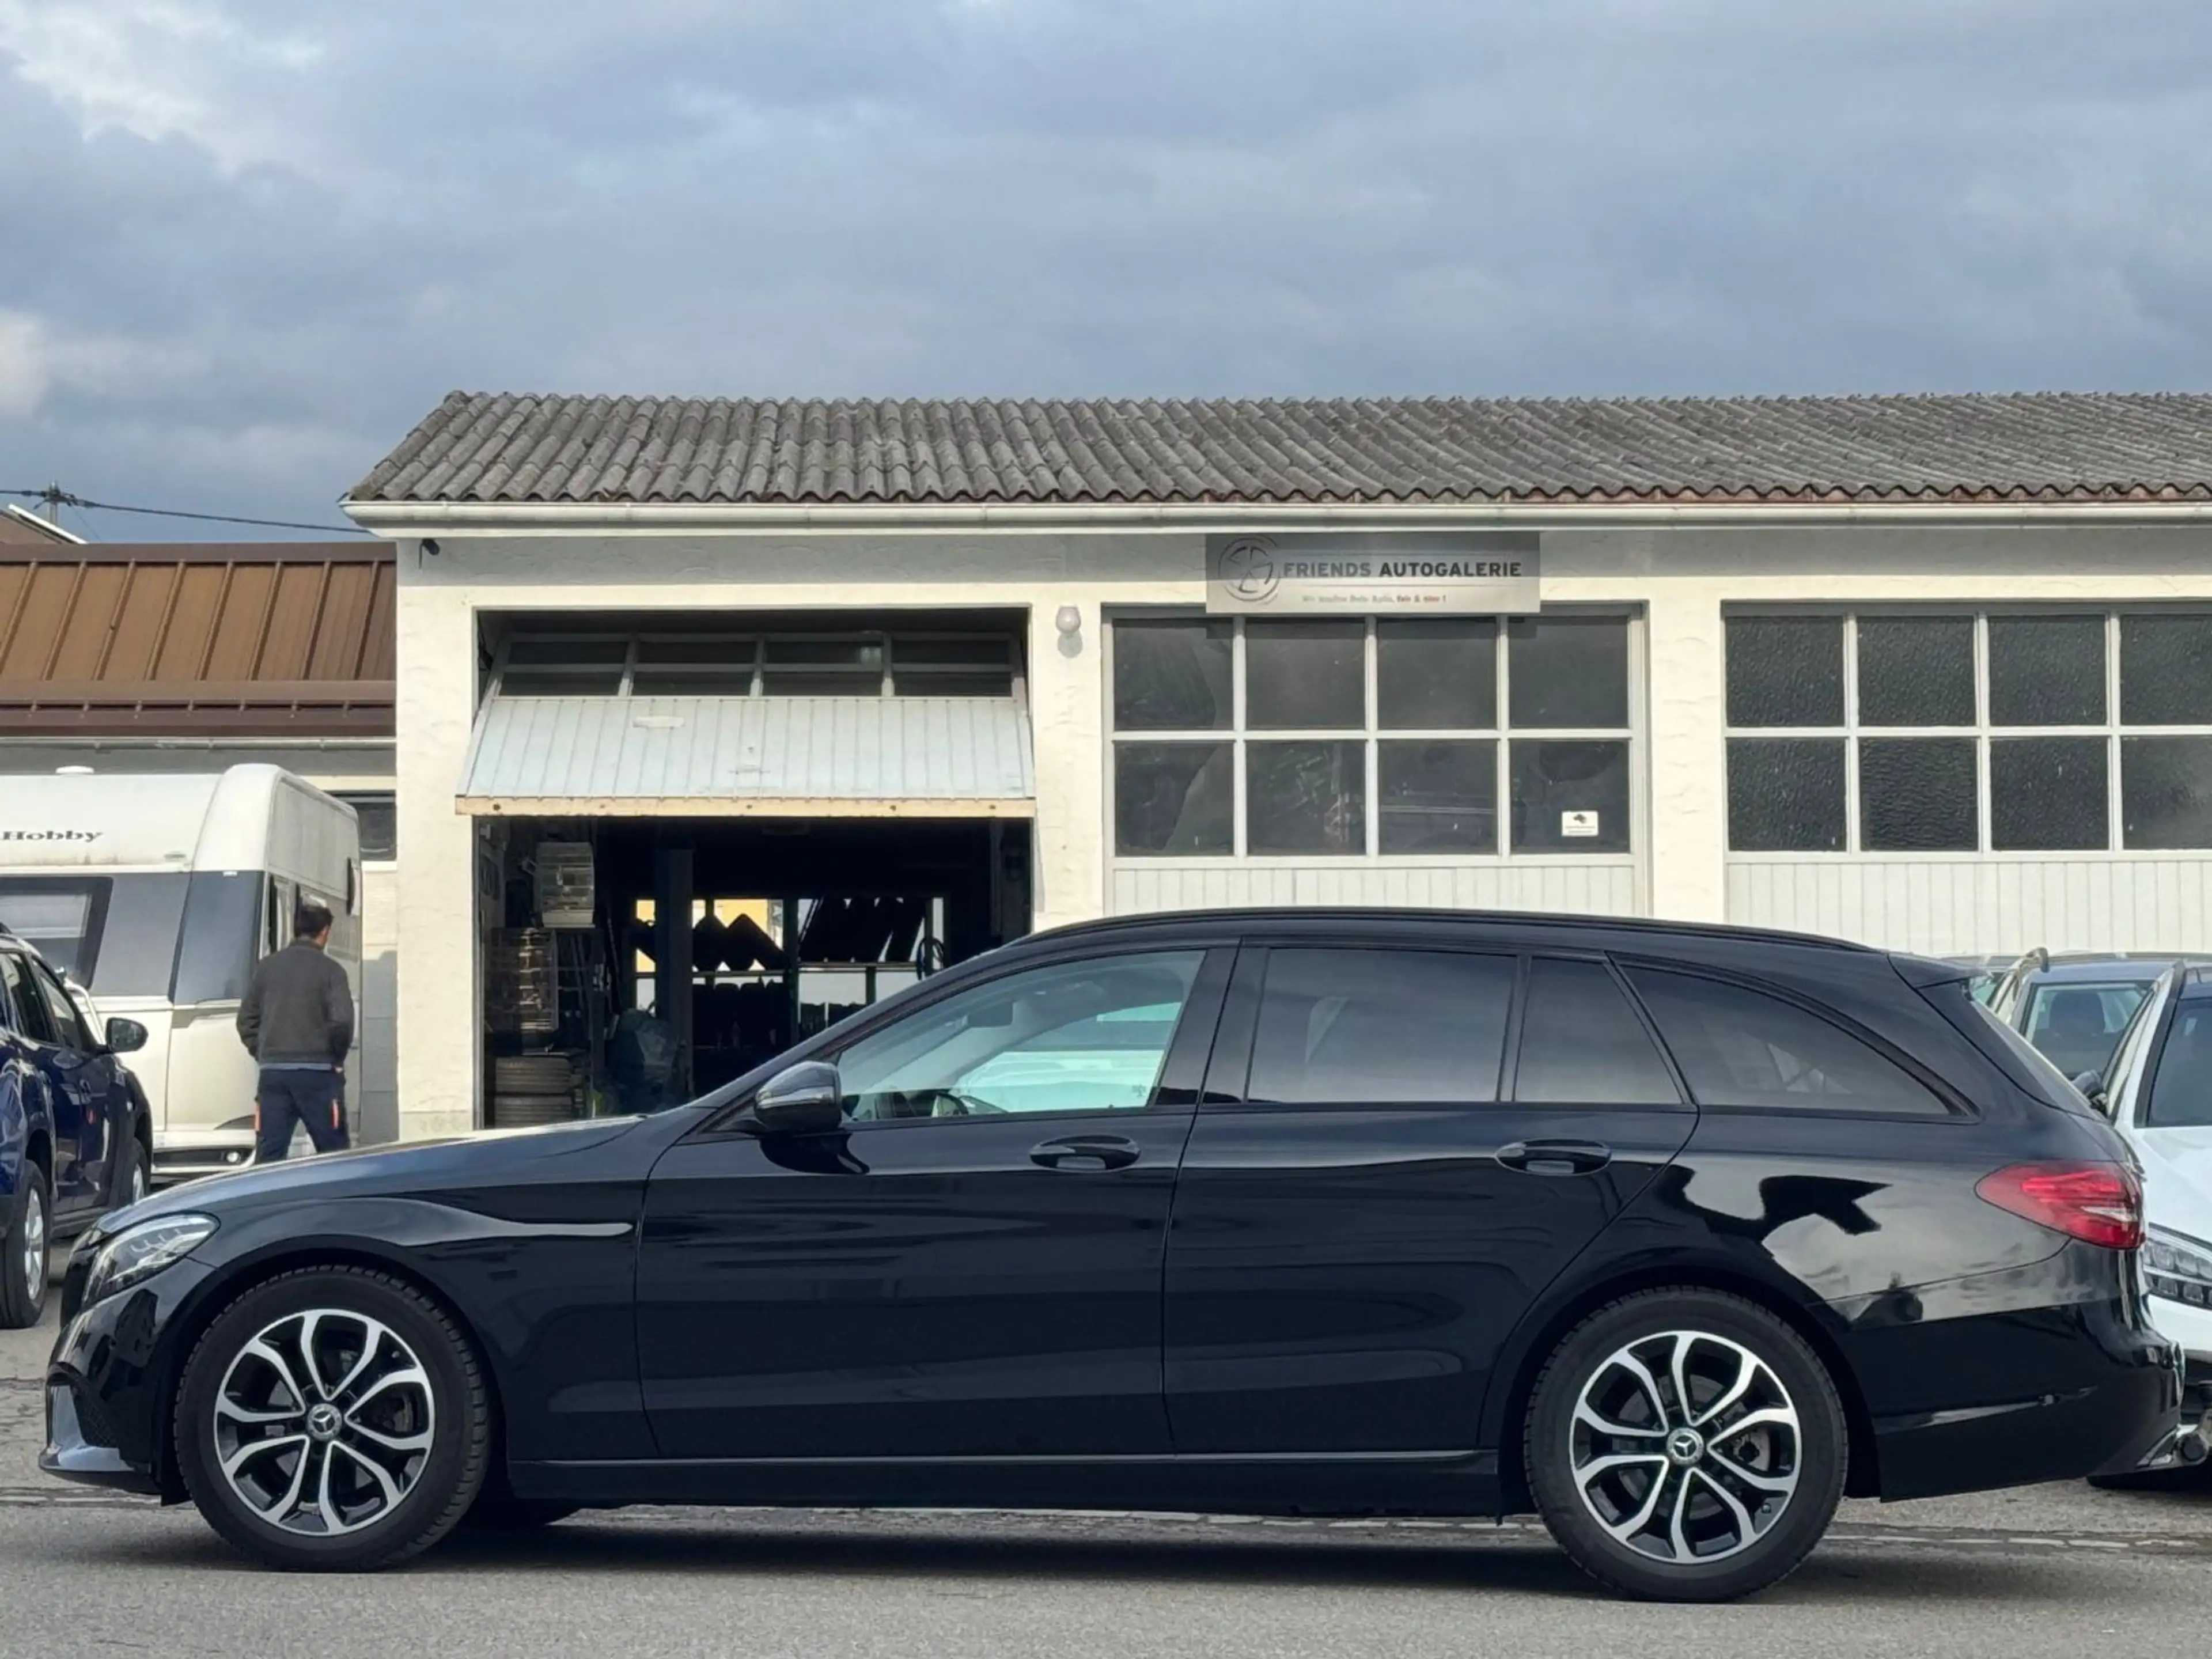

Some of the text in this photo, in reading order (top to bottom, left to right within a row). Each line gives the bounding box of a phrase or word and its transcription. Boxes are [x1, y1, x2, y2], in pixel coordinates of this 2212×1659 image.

[1283, 562, 1522, 577] FRIENDS AUTOGALERIE
[1, 830, 103, 843] Hobby
